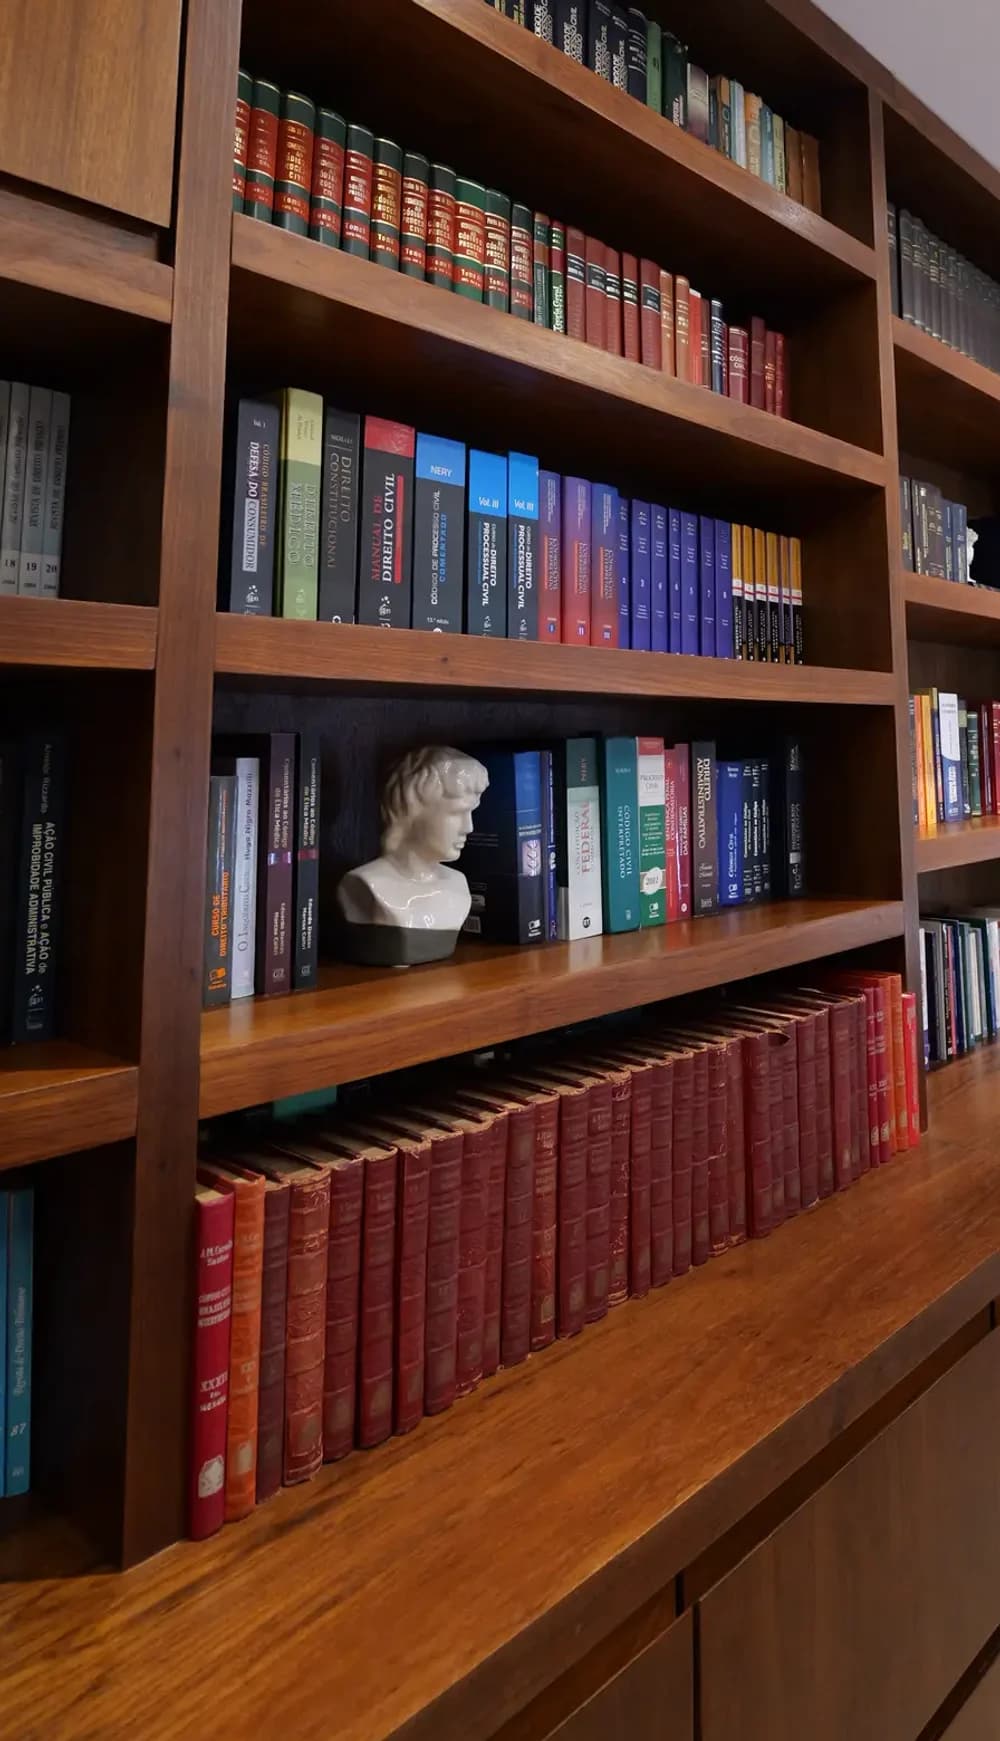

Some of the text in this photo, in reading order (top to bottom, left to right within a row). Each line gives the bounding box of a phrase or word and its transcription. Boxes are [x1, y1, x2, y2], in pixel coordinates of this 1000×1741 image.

[245, 441, 259, 570] DEFESA DO CONSUMIDOR
[340, 455, 352, 524] DIREITO
[430, 465, 453, 478] NERY
[303, 484, 315, 568] DIREITO
[371, 495, 382, 581] MANUAL DE
[381, 472, 396, 583] DIREITO CIVIL
[430, 489, 441, 606] CÓDIGO DE PROCESSO CIVIL
[438, 512, 447, 583] COMENTADO
[482, 522, 490, 581] PROCESSUAL
[481, 582, 489, 607] CIVIL
[490, 549, 498, 587] DIREITO
[517, 524, 526, 609] PROCESSUAL CIVIL
[525, 551, 533, 589] DIREITO
[696, 757, 706, 849] ADMINISTRATIVO
[703, 757, 712, 801] DIREITO
[44, 851, 55, 877] CIVIL
[46, 821, 58, 849] AÇÃO
[580, 799, 591, 874] FEDERAL
[617, 805, 627, 879] INTERPRETADO
[624, 804, 633, 875] CÓDIGO CIVIL
[26, 822, 44, 976] IMPROBIDADE ADMINISTRATIVA
[42, 878, 54, 921] PÚBLICA
[39, 931, 51, 959] AÇÃO
